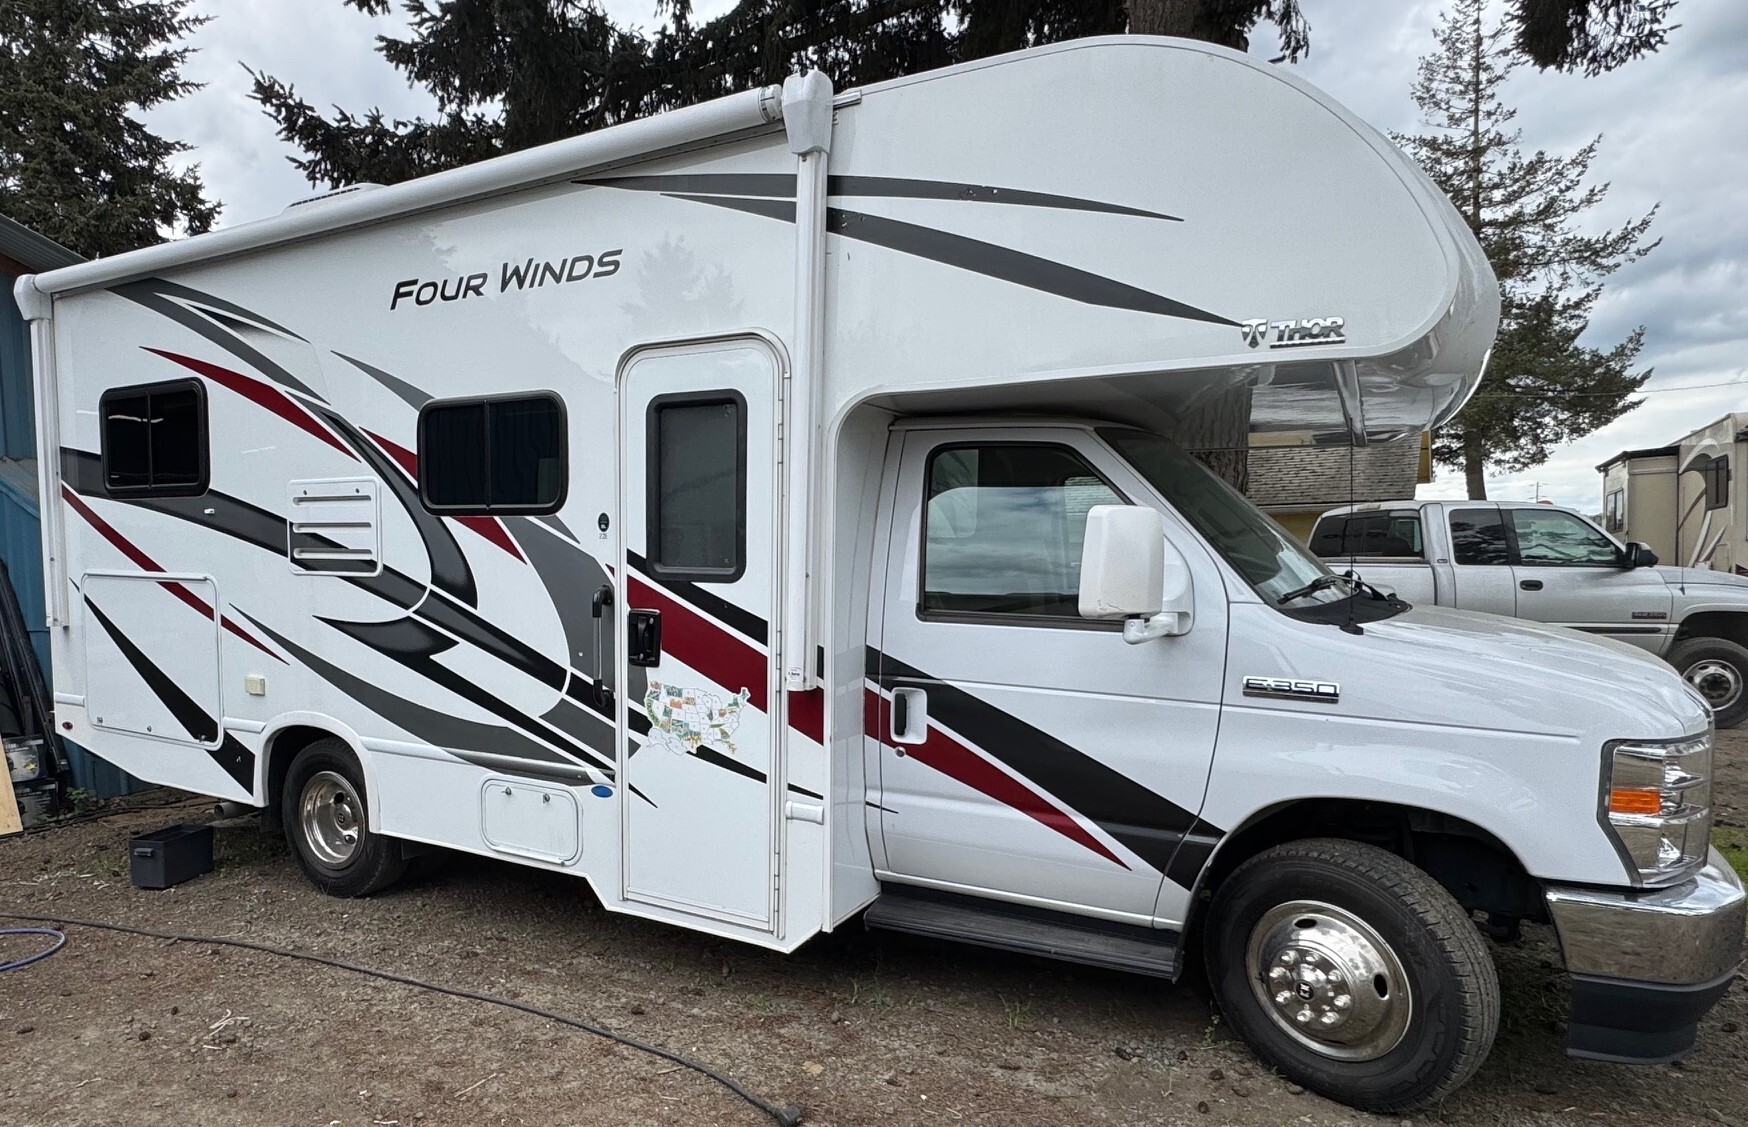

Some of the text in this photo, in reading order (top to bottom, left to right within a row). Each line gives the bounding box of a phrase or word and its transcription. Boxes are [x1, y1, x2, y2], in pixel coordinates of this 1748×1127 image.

[389, 248, 625, 311] FOUR WINDS
[1270, 316, 1345, 342] THOR
